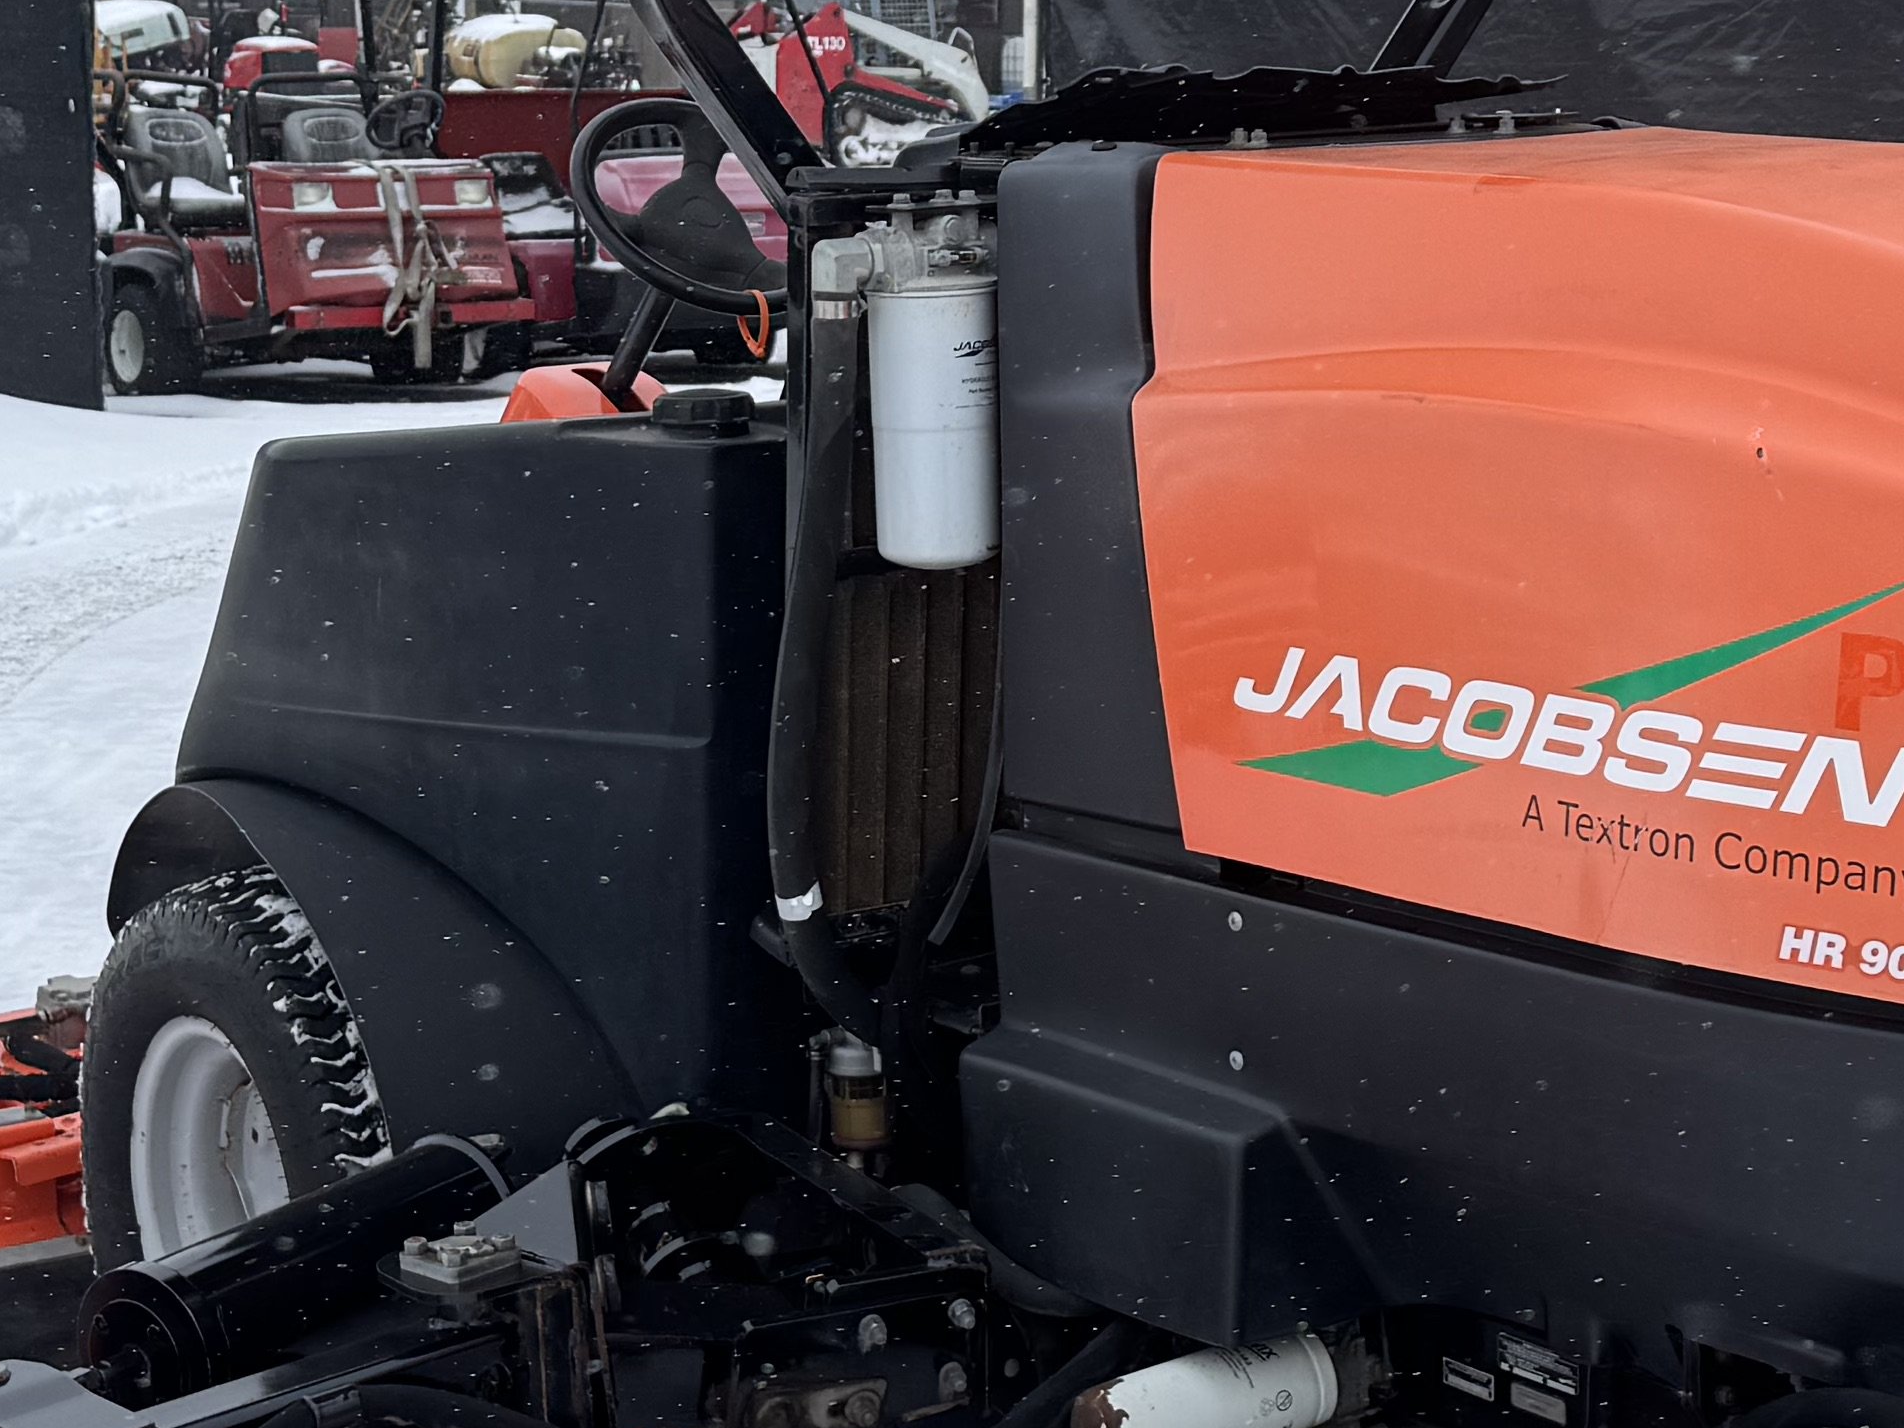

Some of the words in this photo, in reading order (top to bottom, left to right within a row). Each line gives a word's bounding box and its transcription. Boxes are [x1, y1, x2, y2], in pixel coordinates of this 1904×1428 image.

[1521, 794, 1544, 833] A
[1556, 799, 1695, 863] Textron
[1778, 925, 1847, 969] HR
